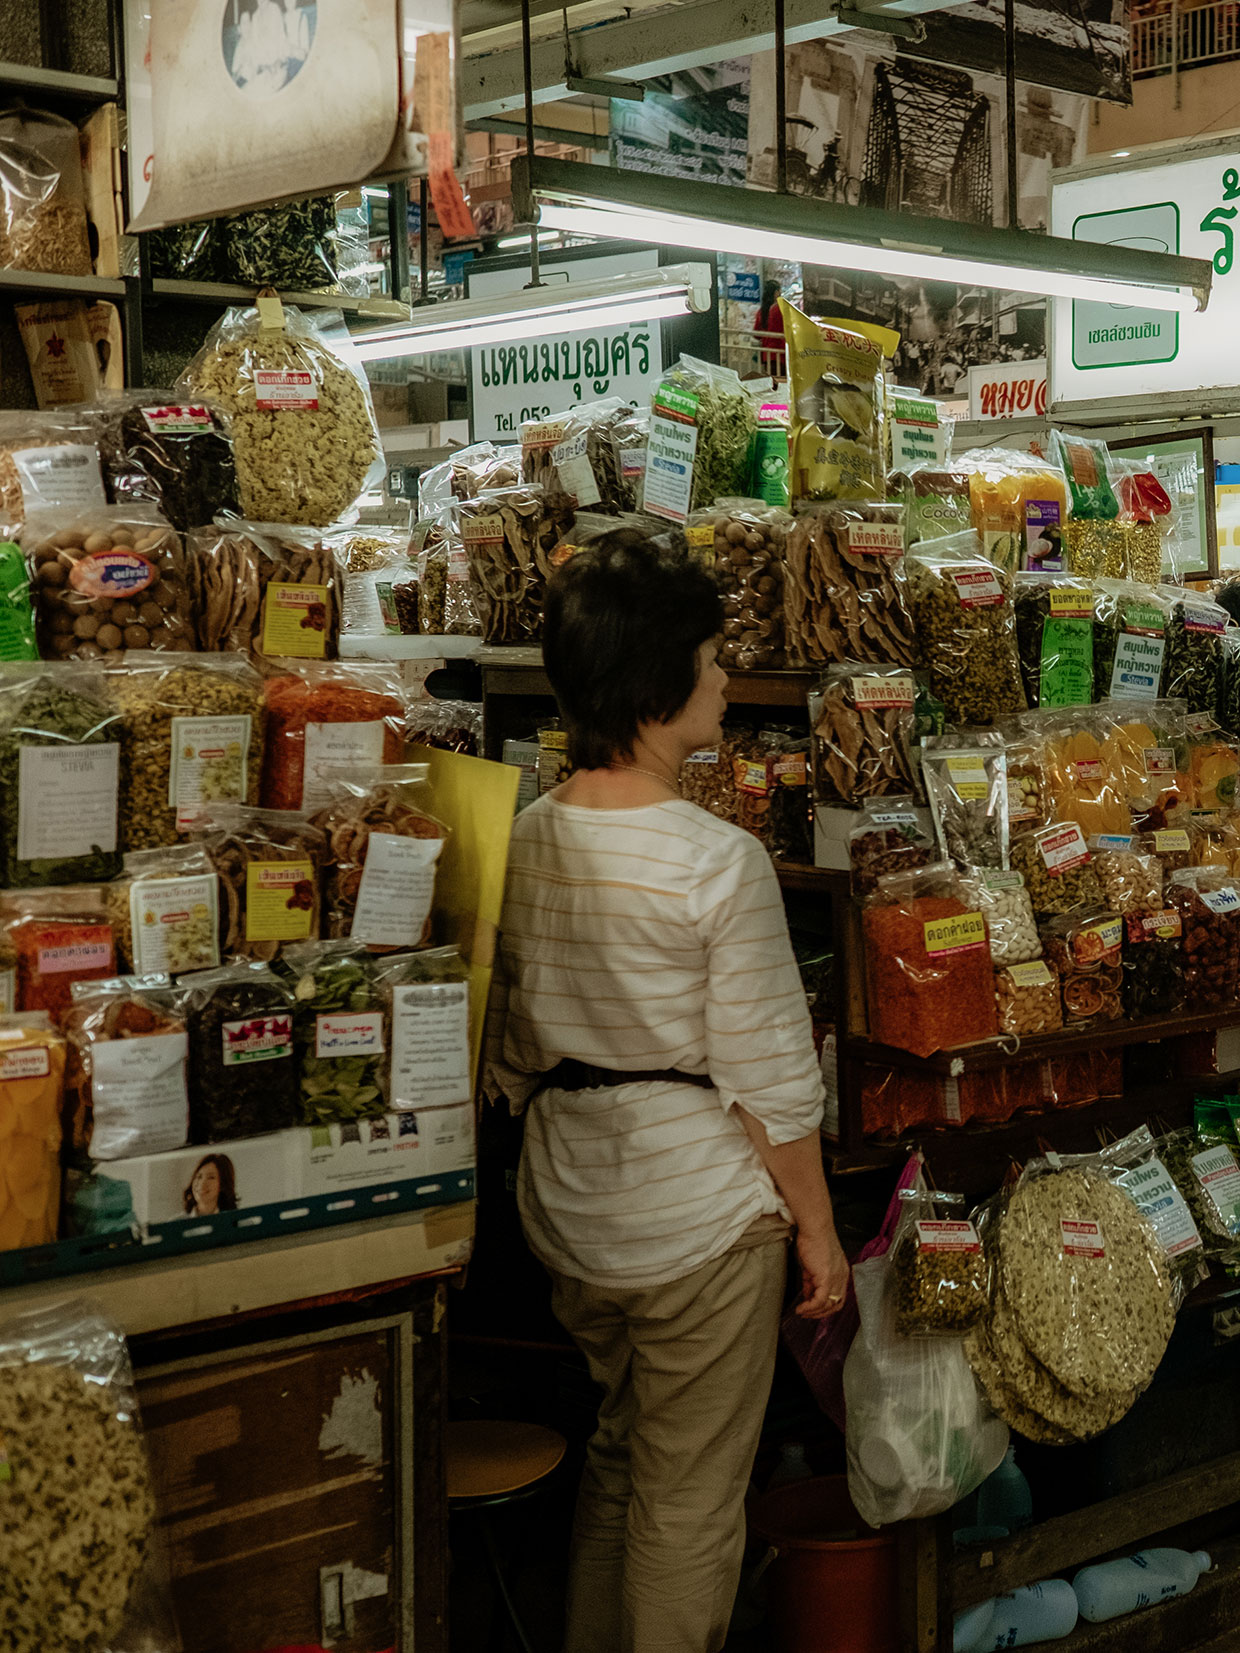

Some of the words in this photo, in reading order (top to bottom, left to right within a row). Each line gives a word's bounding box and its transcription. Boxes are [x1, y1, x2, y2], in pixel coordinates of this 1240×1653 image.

[1088, 321, 1161, 344] เชลล์ชวนชิม
[480, 320, 650, 400] แหนมบุญศรี
[897, 402, 937, 419] หญ้าหวาน
[495, 413, 517, 431] Tel.
[654, 422, 692, 444] สมุนไพร
[903, 429, 934, 443] สมุนไพร
[649, 440, 693, 463] หญ้าหวาน
[901, 445, 937, 461] หญ้าหวาน
[1128, 606, 1164, 623] หญ้าหวาน
[1123, 639, 1160, 657] สมุนไพร
[1117, 656, 1161, 674] หญ้าหวาน
[1127, 674, 1150, 686] Stevia
[1142, 910, 1180, 930] กระเจี๊ยบ
[926, 918, 983, 942] ดอกคำฝอย
